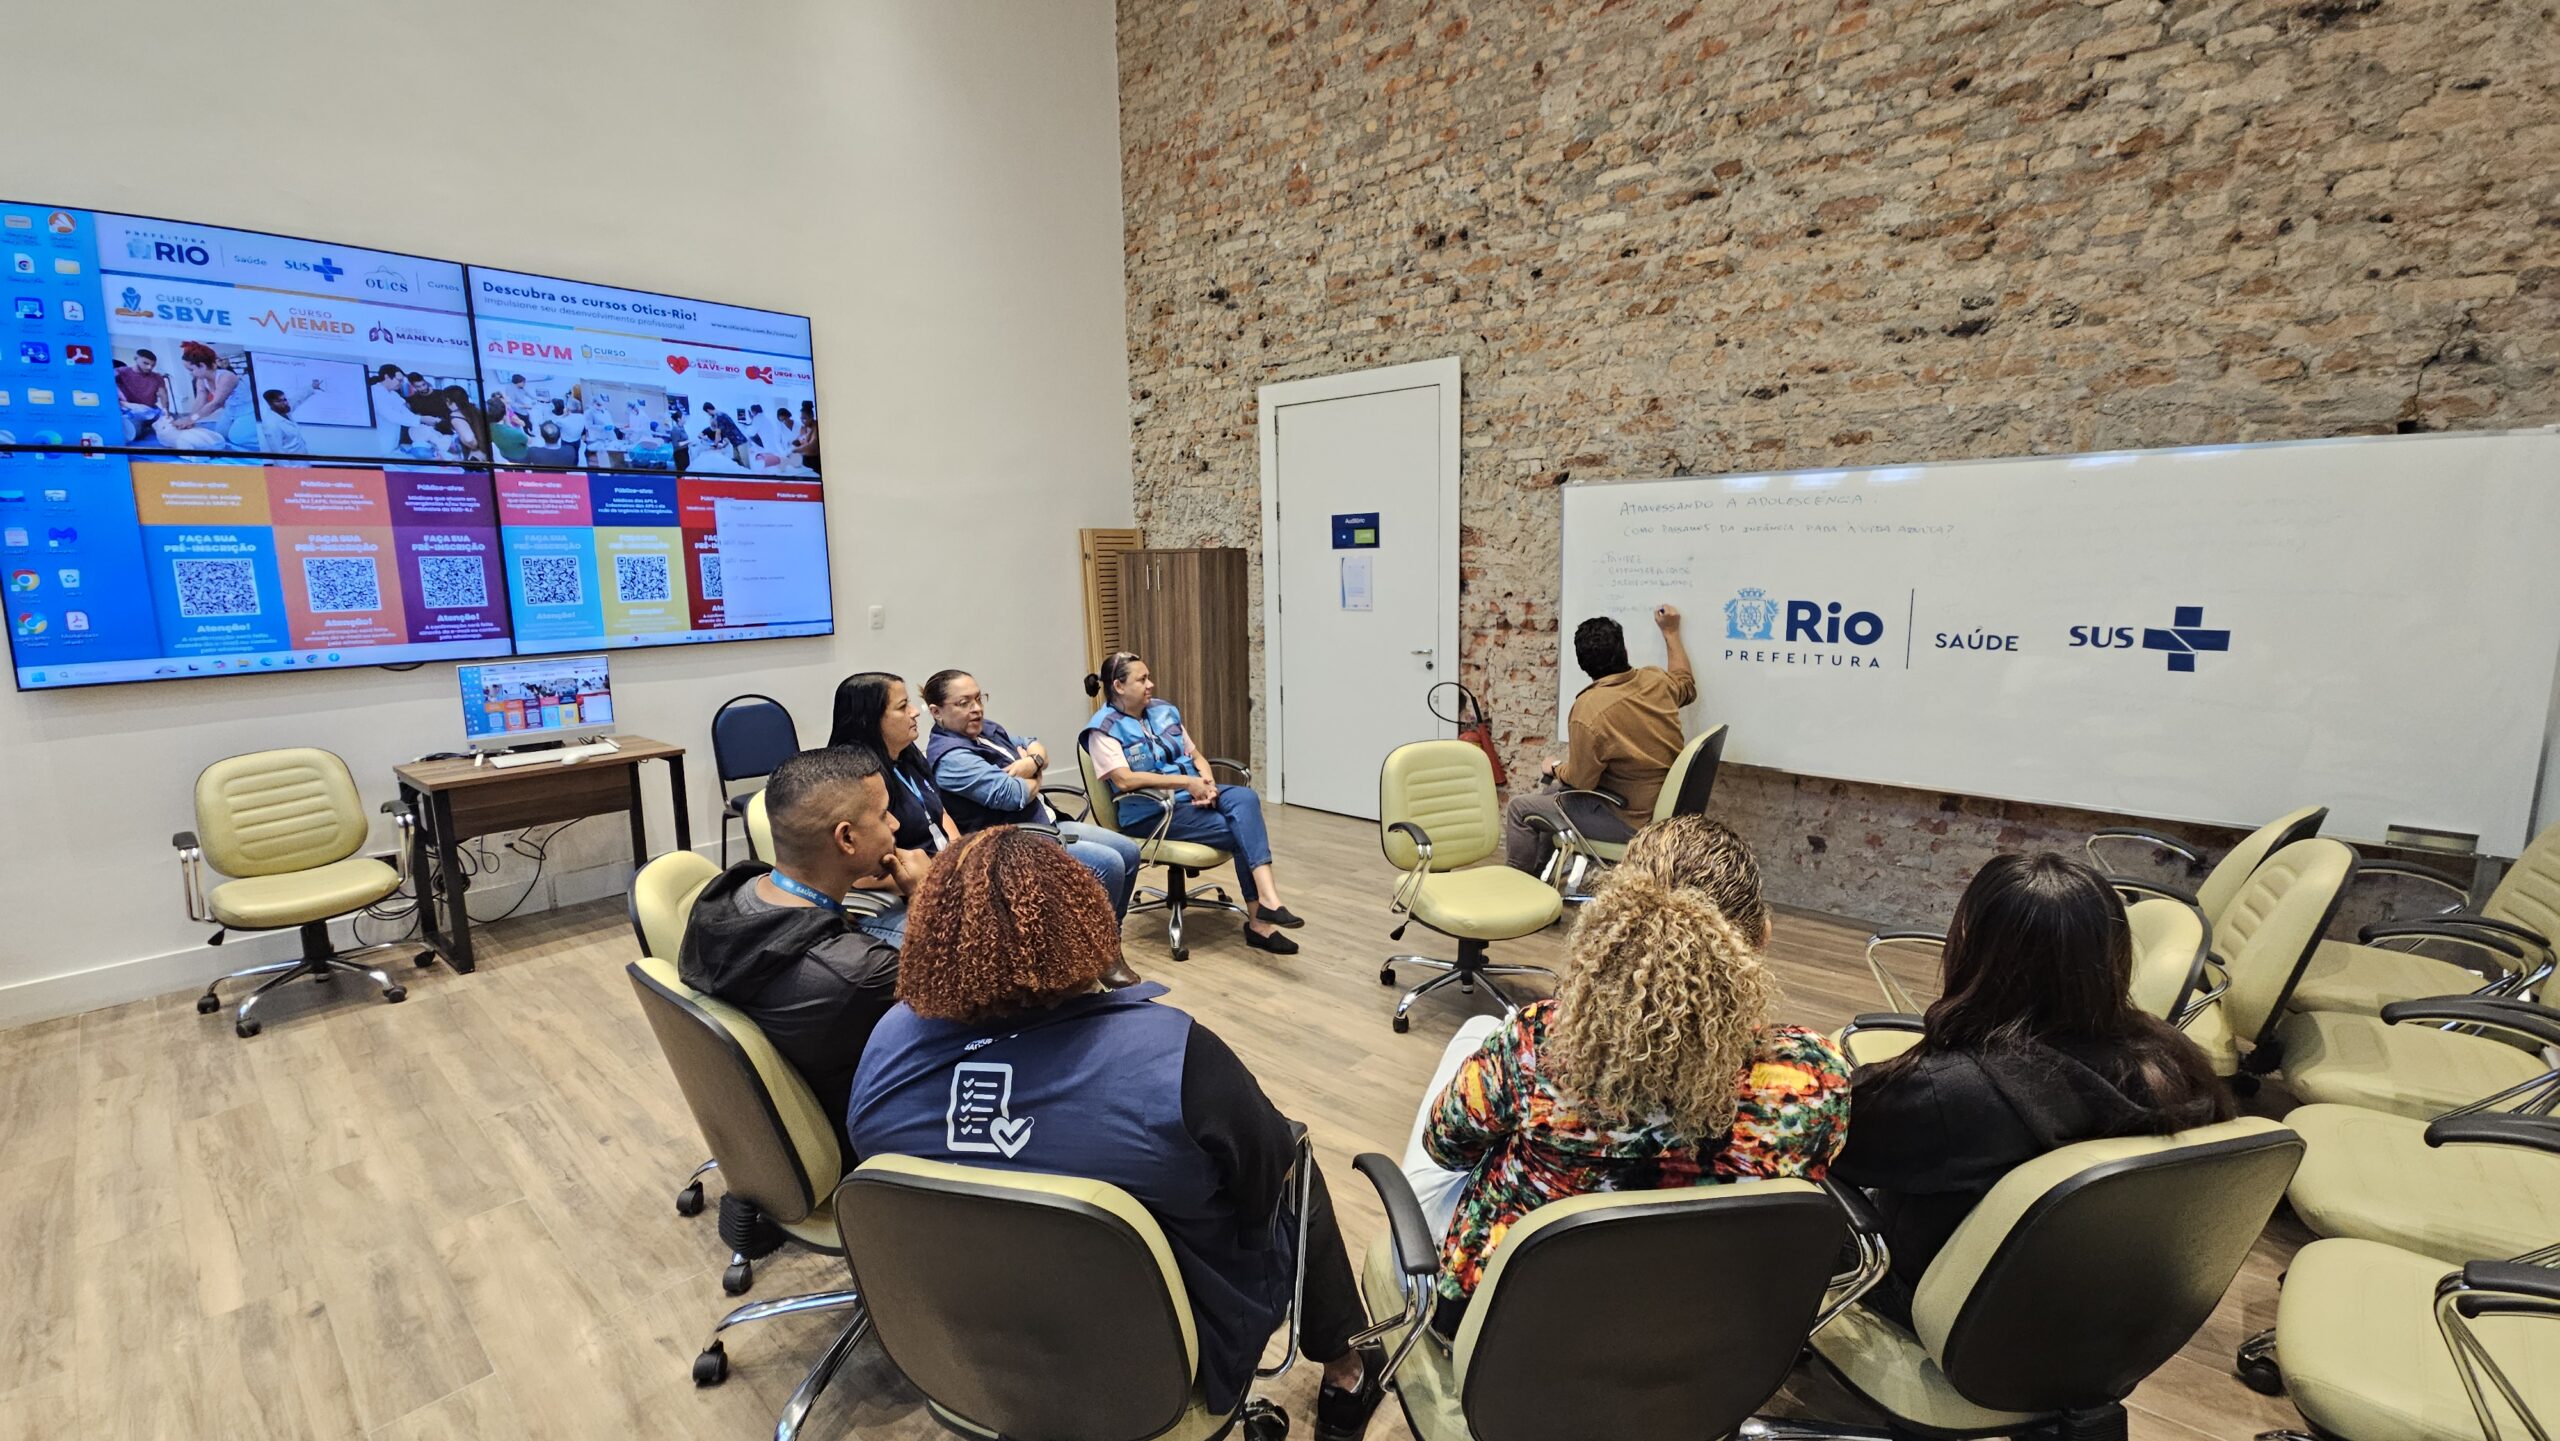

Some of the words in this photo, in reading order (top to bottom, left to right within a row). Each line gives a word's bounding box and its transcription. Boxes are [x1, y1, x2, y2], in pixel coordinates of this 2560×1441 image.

[125, 230, 206, 244] PREFEITURA
[154, 242, 209, 266] RIO
[234, 255, 267, 266] Saúde
[284, 259, 311, 272] SUS
[427, 281, 460, 292] Cursos
[156, 294, 203, 305] CURSO
[483, 281, 556, 301] Descubra
[561, 294, 577, 304] os
[582, 297, 627, 312] cursos
[631, 303, 697, 322] Otics-Rio!
[157, 304, 232, 326] SBVE
[289, 307, 332, 319] CURSO
[540, 305, 557, 313] seu
[559, 307, 636, 324] desenvolvimento
[637, 318, 685, 330] profissional
[396, 332, 470, 346] MANEVA-SUS
[507, 340, 573, 361] PBVM
[594, 347, 626, 358] CURSO
[697, 362, 740, 373] SAVE-RIO
[1726, 497, 1737, 509] A
[1623, 526, 1655, 538] COMO
[1720, 524, 1735, 533] DA
[1806, 524, 1838, 533] PARA
[1785, 600, 1884, 646] Rio
[1935, 627, 2019, 652] SAÚDE
[2068, 625, 2134, 649] SUS
[1725, 650, 1880, 668] PREFEITURA
